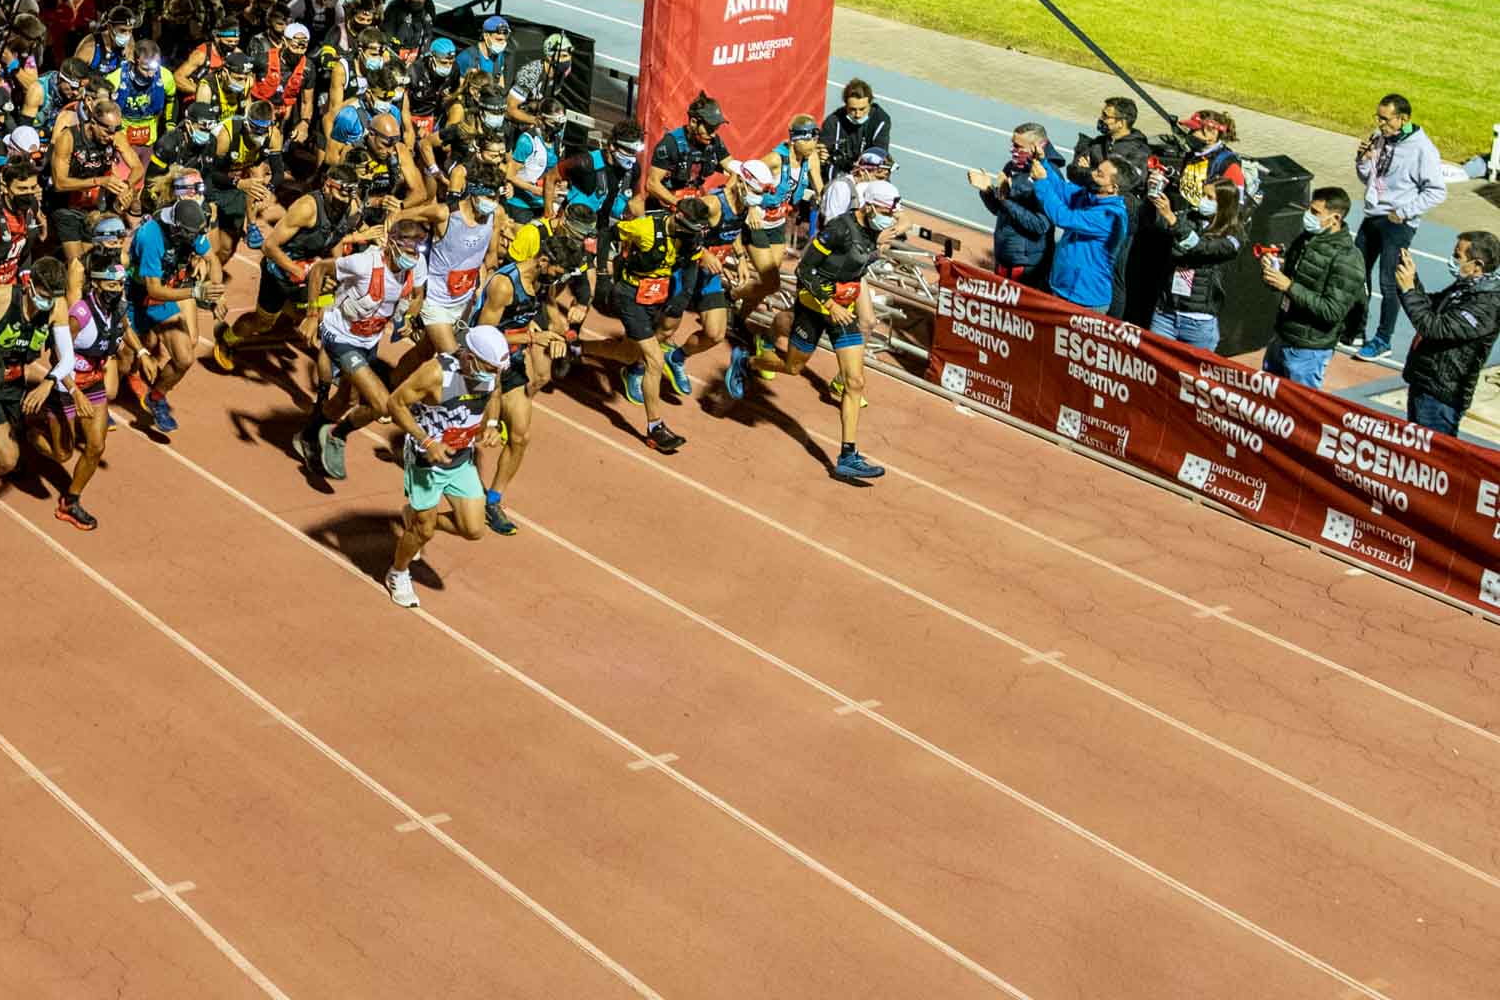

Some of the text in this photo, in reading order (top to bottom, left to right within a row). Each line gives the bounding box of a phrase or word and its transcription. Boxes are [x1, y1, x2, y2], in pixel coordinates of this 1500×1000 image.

[956, 277, 1021, 306] CASTELLÓN
[938, 288, 1035, 341] ESCENARIO
[1070, 315, 1142, 349] CASTELLÓN
[952, 320, 1010, 358] DEPORTIVO
[1054, 326, 1157, 386] ESCENARIO
[967, 368, 1010, 390] DIPUTACIÓ
[1068, 362, 1129, 403] DEPORTIVO
[1200, 361, 1279, 399] CASTELLÓN
[964, 389, 1008, 411] CASTELLÓ
[1178, 371, 1295, 439] ESCENARIO
[1082, 413, 1126, 436] DIPUTACIÓ
[1196, 410, 1263, 453] DEPORTIVO
[1342, 412, 1433, 452] CASTELLÓN
[1211, 463, 1263, 489] DIPUTACIÓ
[1316, 423, 1449, 496] ESCENARIO
[1203, 483, 1257, 510] CASTELLÓ
[1334, 463, 1409, 512] DEPORTIVO
[1355, 519, 1411, 547] DIPUTACIÓ
[1350, 540, 1409, 569] CASTELLÓ
